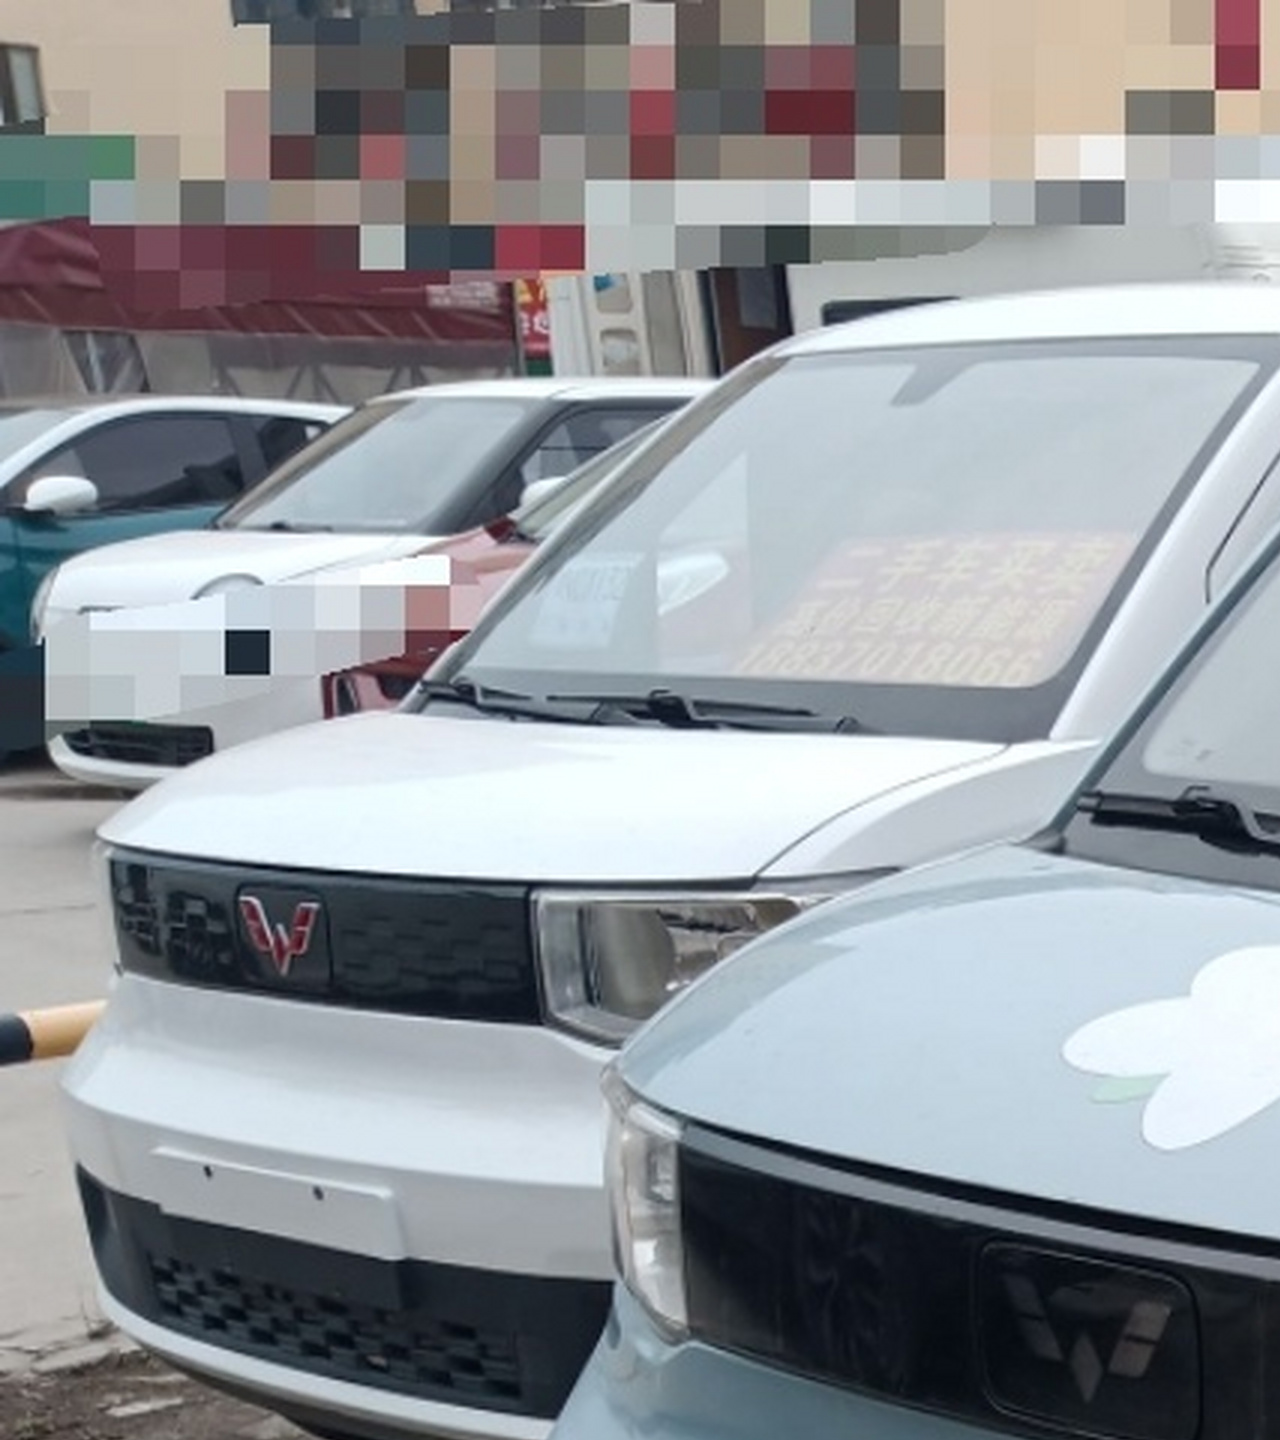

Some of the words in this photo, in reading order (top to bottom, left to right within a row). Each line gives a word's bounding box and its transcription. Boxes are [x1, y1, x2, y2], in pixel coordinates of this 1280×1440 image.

[813, 537, 1116, 594] 二手车买卖
[731, 637, 1044, 686] 18837018066
